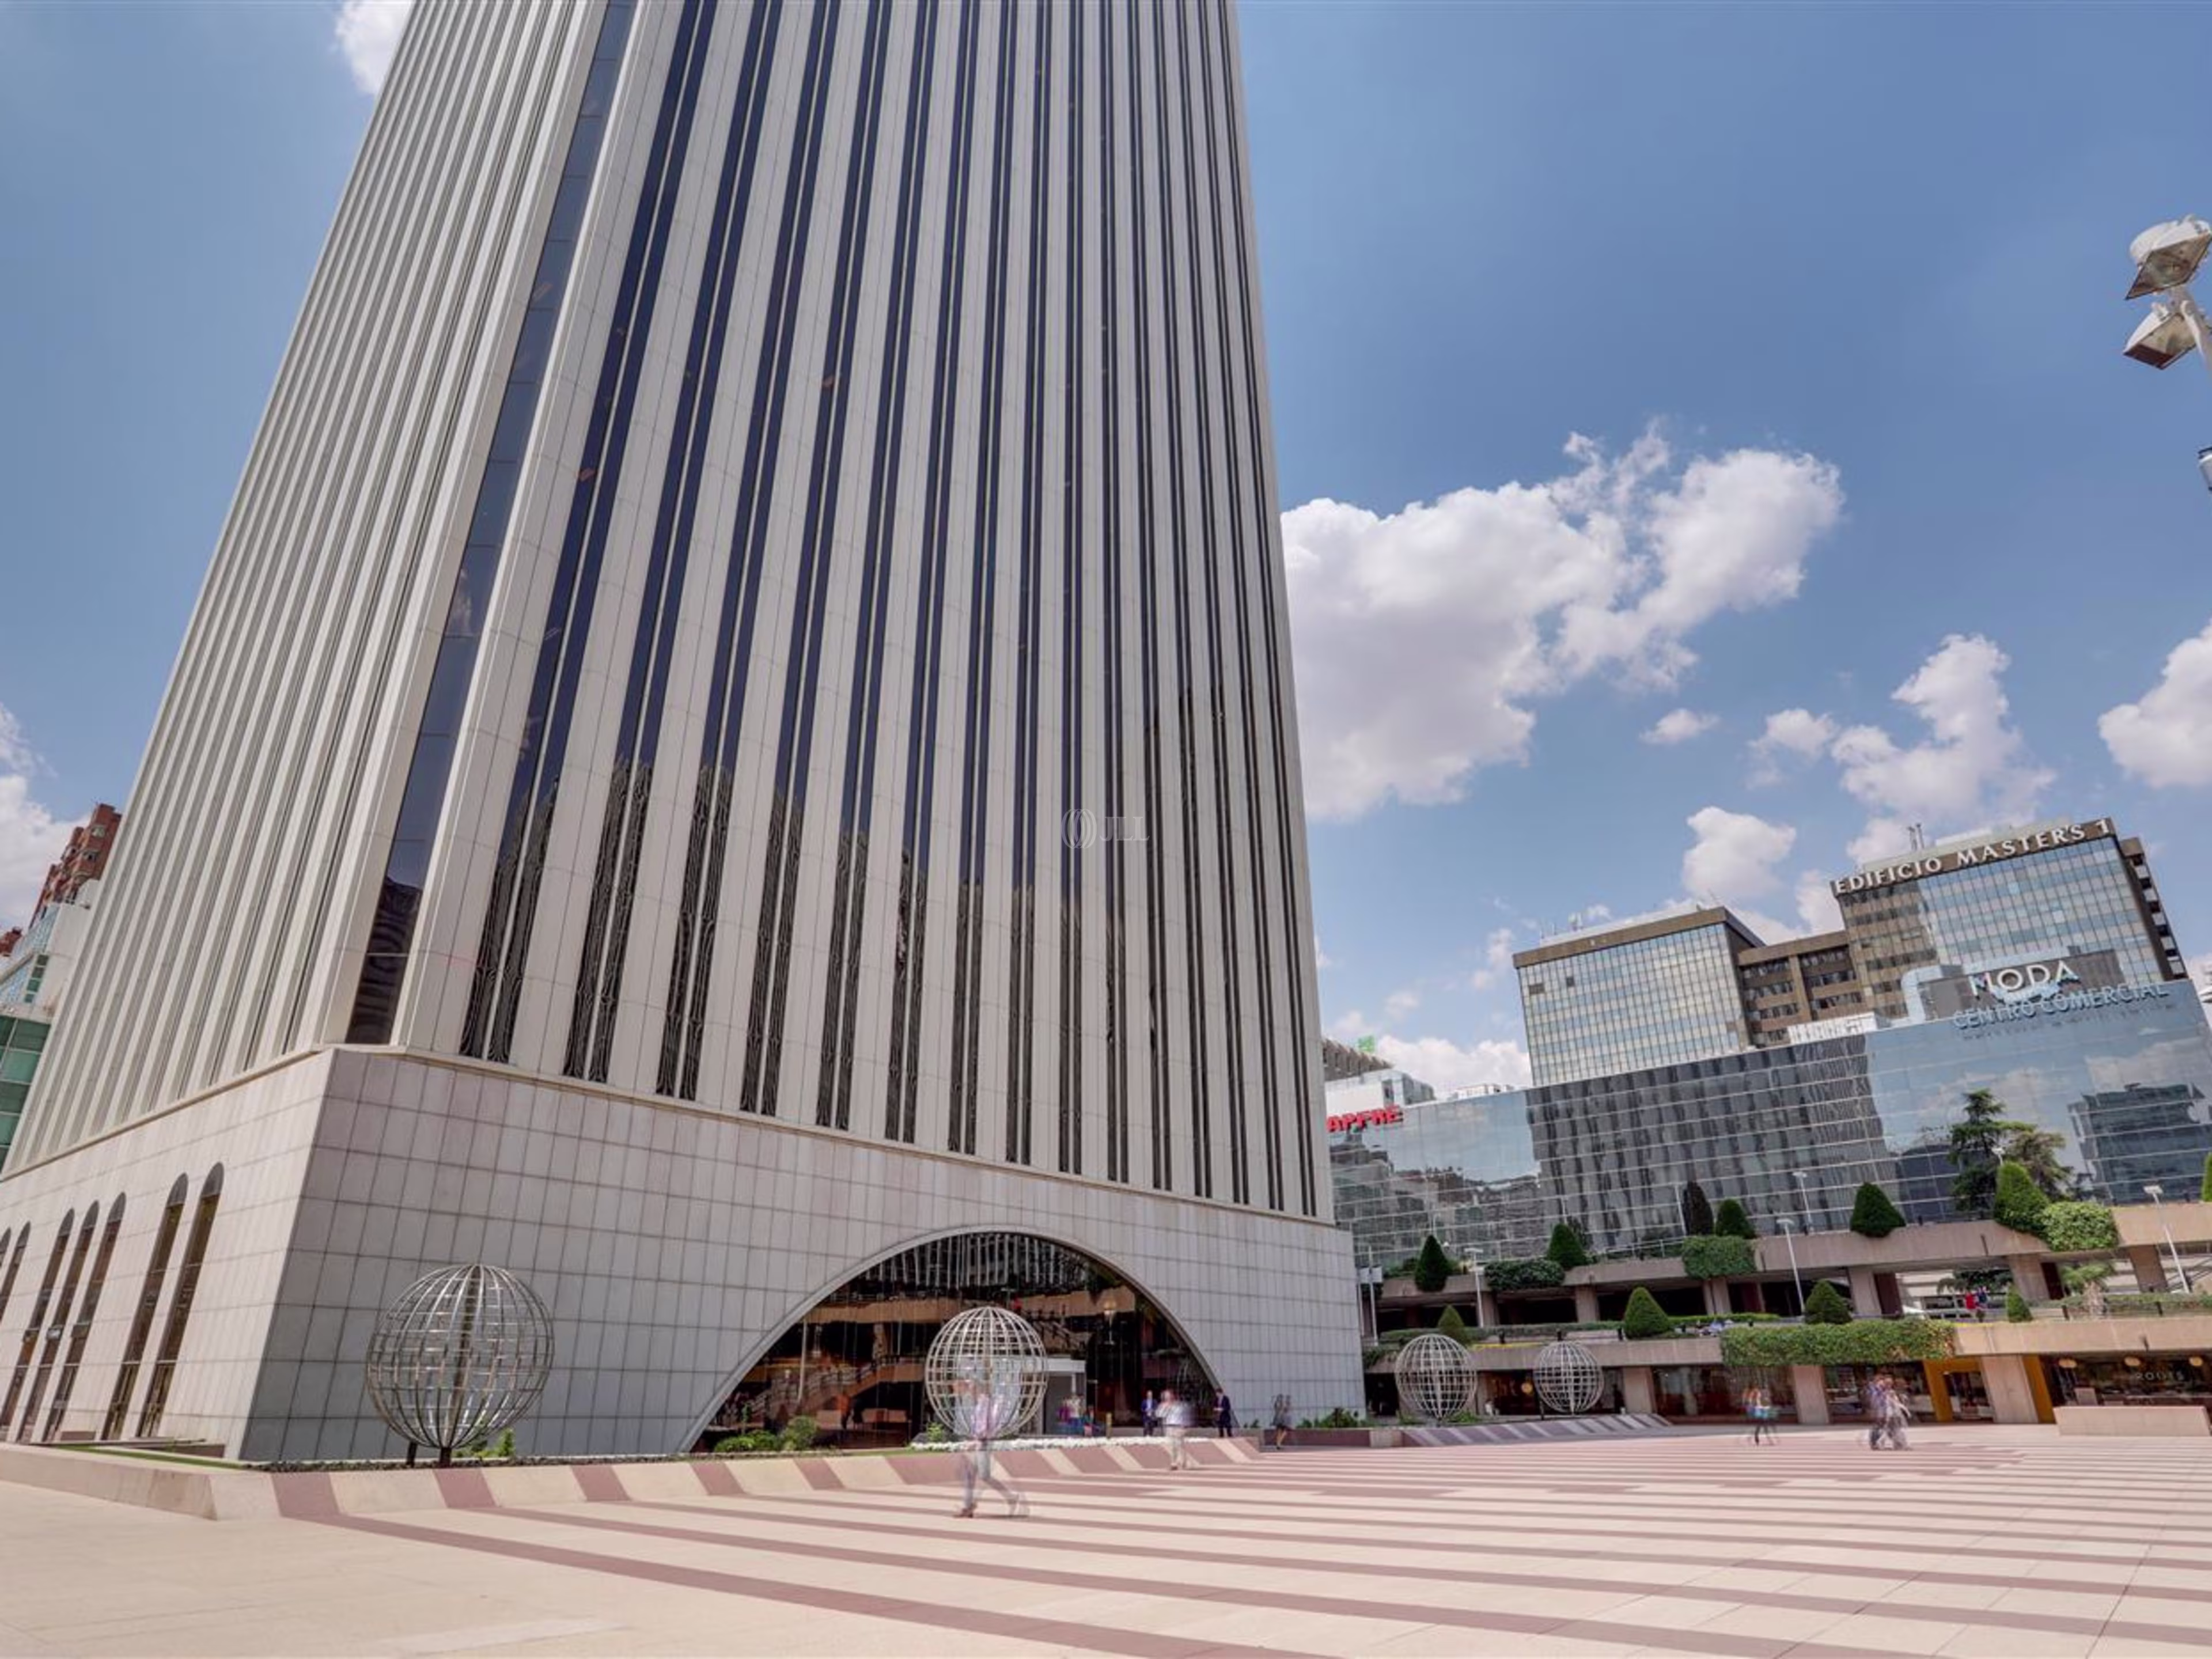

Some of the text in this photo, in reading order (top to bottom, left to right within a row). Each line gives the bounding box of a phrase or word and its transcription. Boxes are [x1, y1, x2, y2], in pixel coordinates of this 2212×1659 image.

[1835, 857, 1942, 893] EDIFICIO
[2096, 819, 2110, 834] 1
[1968, 960, 2080, 996] MODA
[1952, 981, 2169, 1029] CENTRO COMERCIAL
[1327, 1105, 1403, 1132] APFRE
